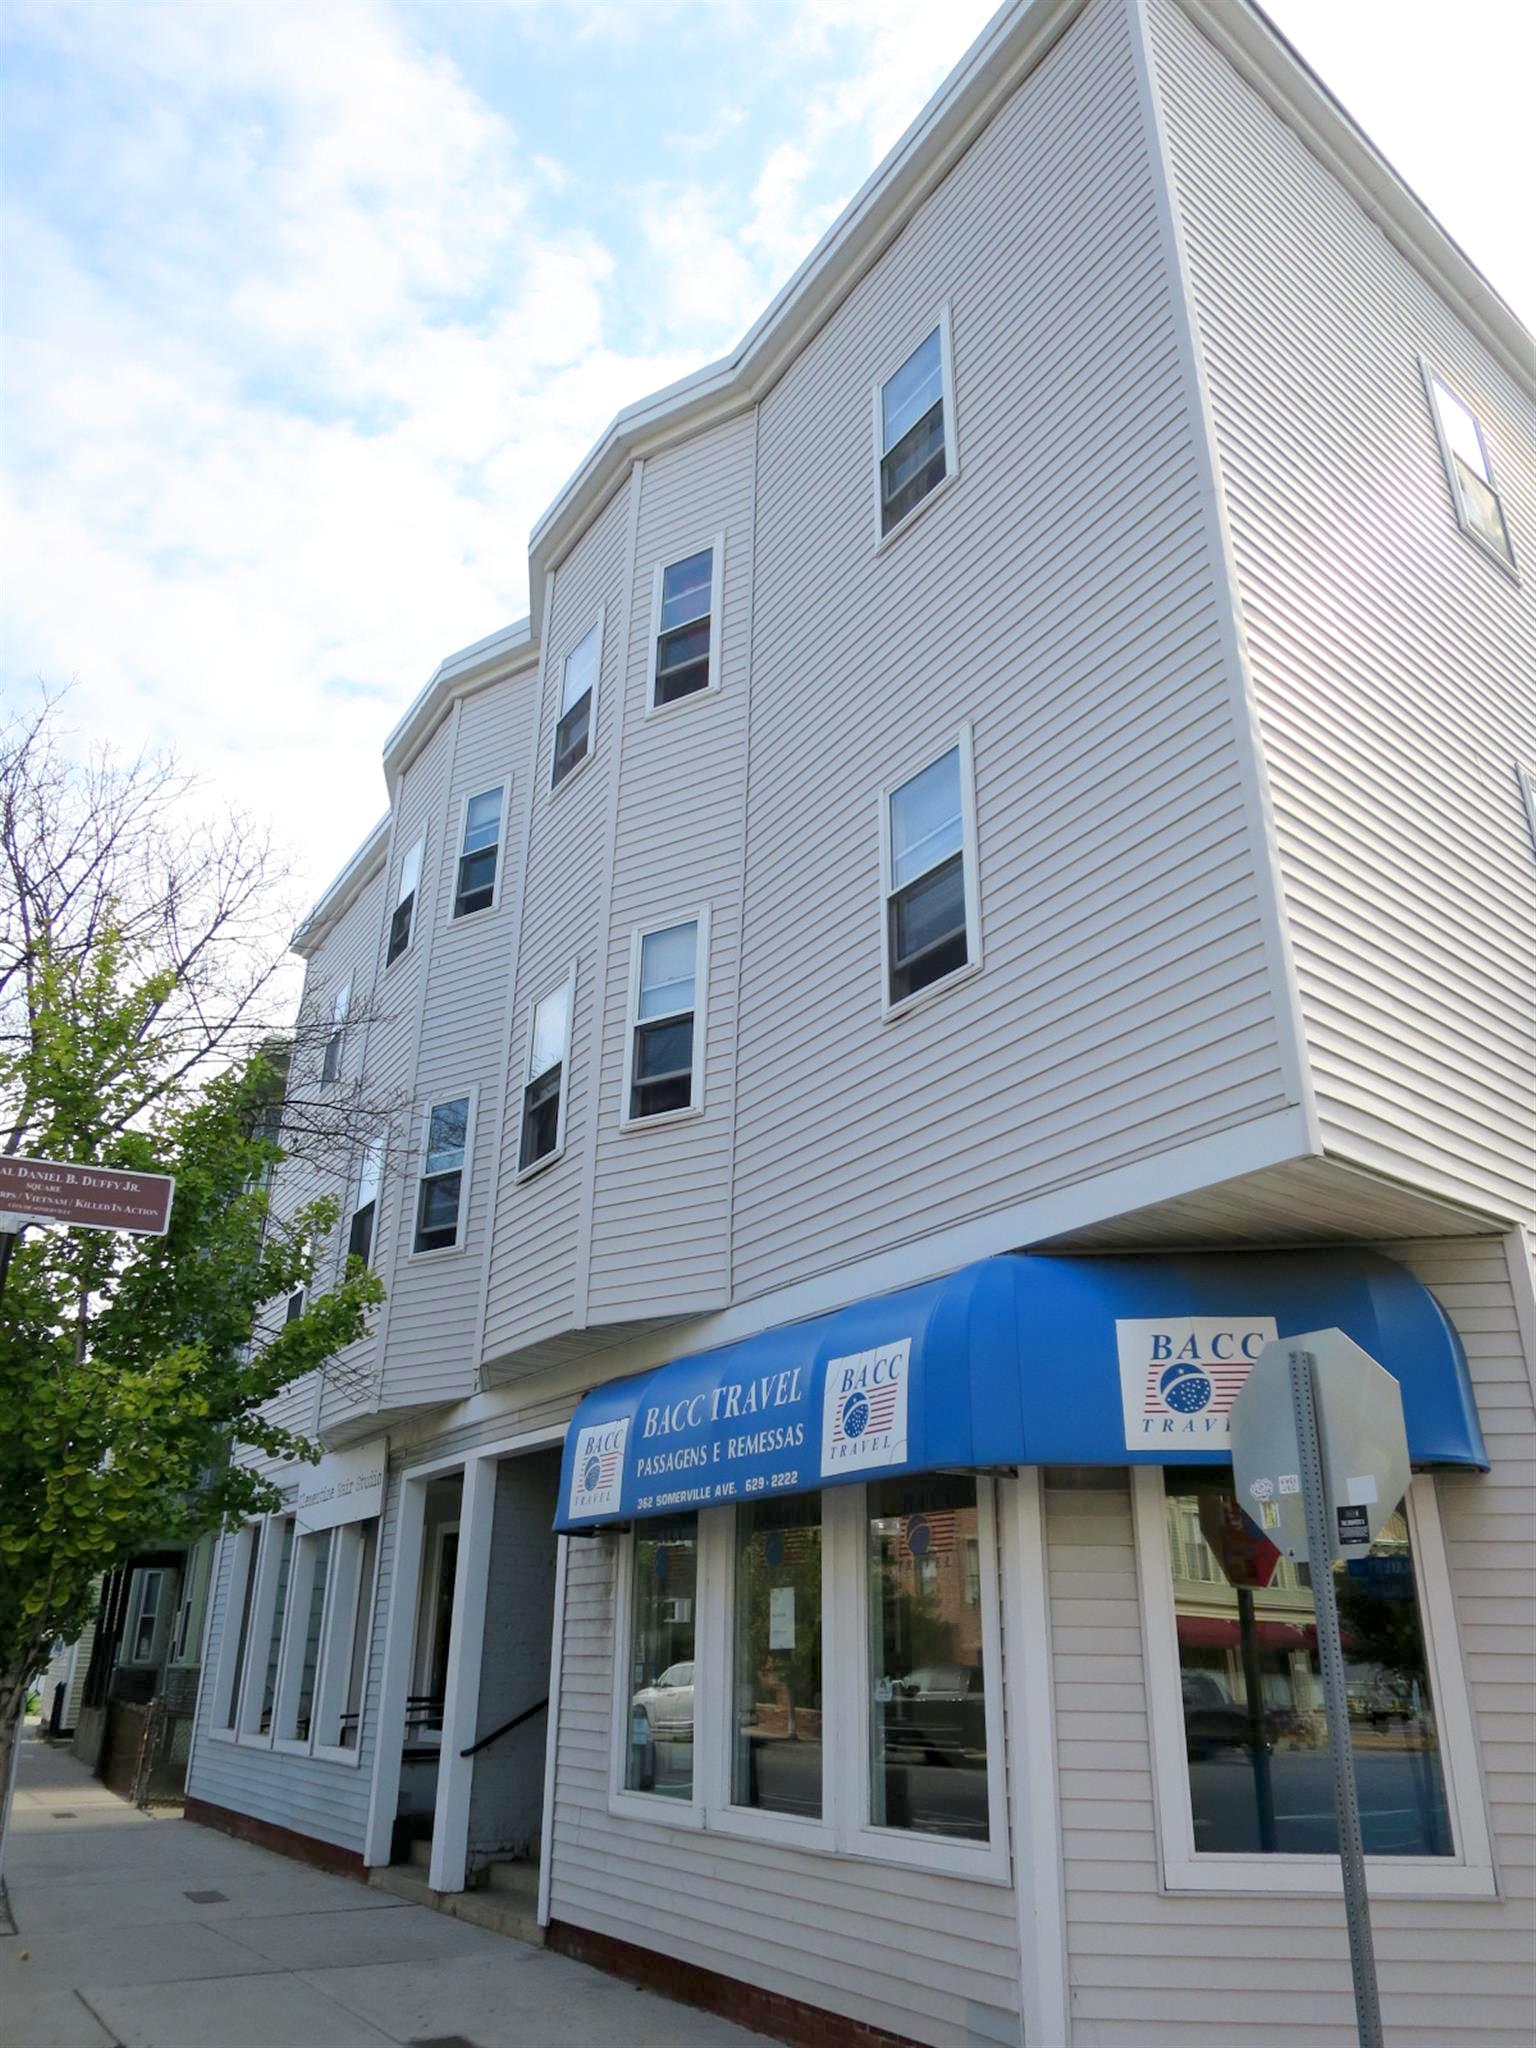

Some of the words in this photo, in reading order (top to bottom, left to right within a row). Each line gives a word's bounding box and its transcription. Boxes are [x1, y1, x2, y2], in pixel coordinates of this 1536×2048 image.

[26, 1182, 61, 1193] SQUARE
[66, 1173, 78, 1185] B.
[82, 1175, 120, 1190] DUFFY
[25, 1192, 68, 1206] VIETNAM
[75, 1199, 111, 1211] KILLED
[123, 1205, 159, 1216] ACTION
[1150, 1332, 1264, 1360] BACC
[840, 1354, 903, 1393] BACC
[642, 1394, 705, 1439] BACC
[710, 1367, 802, 1422] TRAVEL
[585, 1429, 624, 1456] BACC
[636, 1445, 707, 1478] PASSAGENS
[713, 1441, 721, 1463] E
[727, 1423, 804, 1460] REMESSAS
[830, 1434, 891, 1460] TRAVEL
[575, 1490, 611, 1506] TRAVEL
[655, 1486, 711, 1507] SOMERVILLE
[714, 1481, 737, 1497] AVE.
